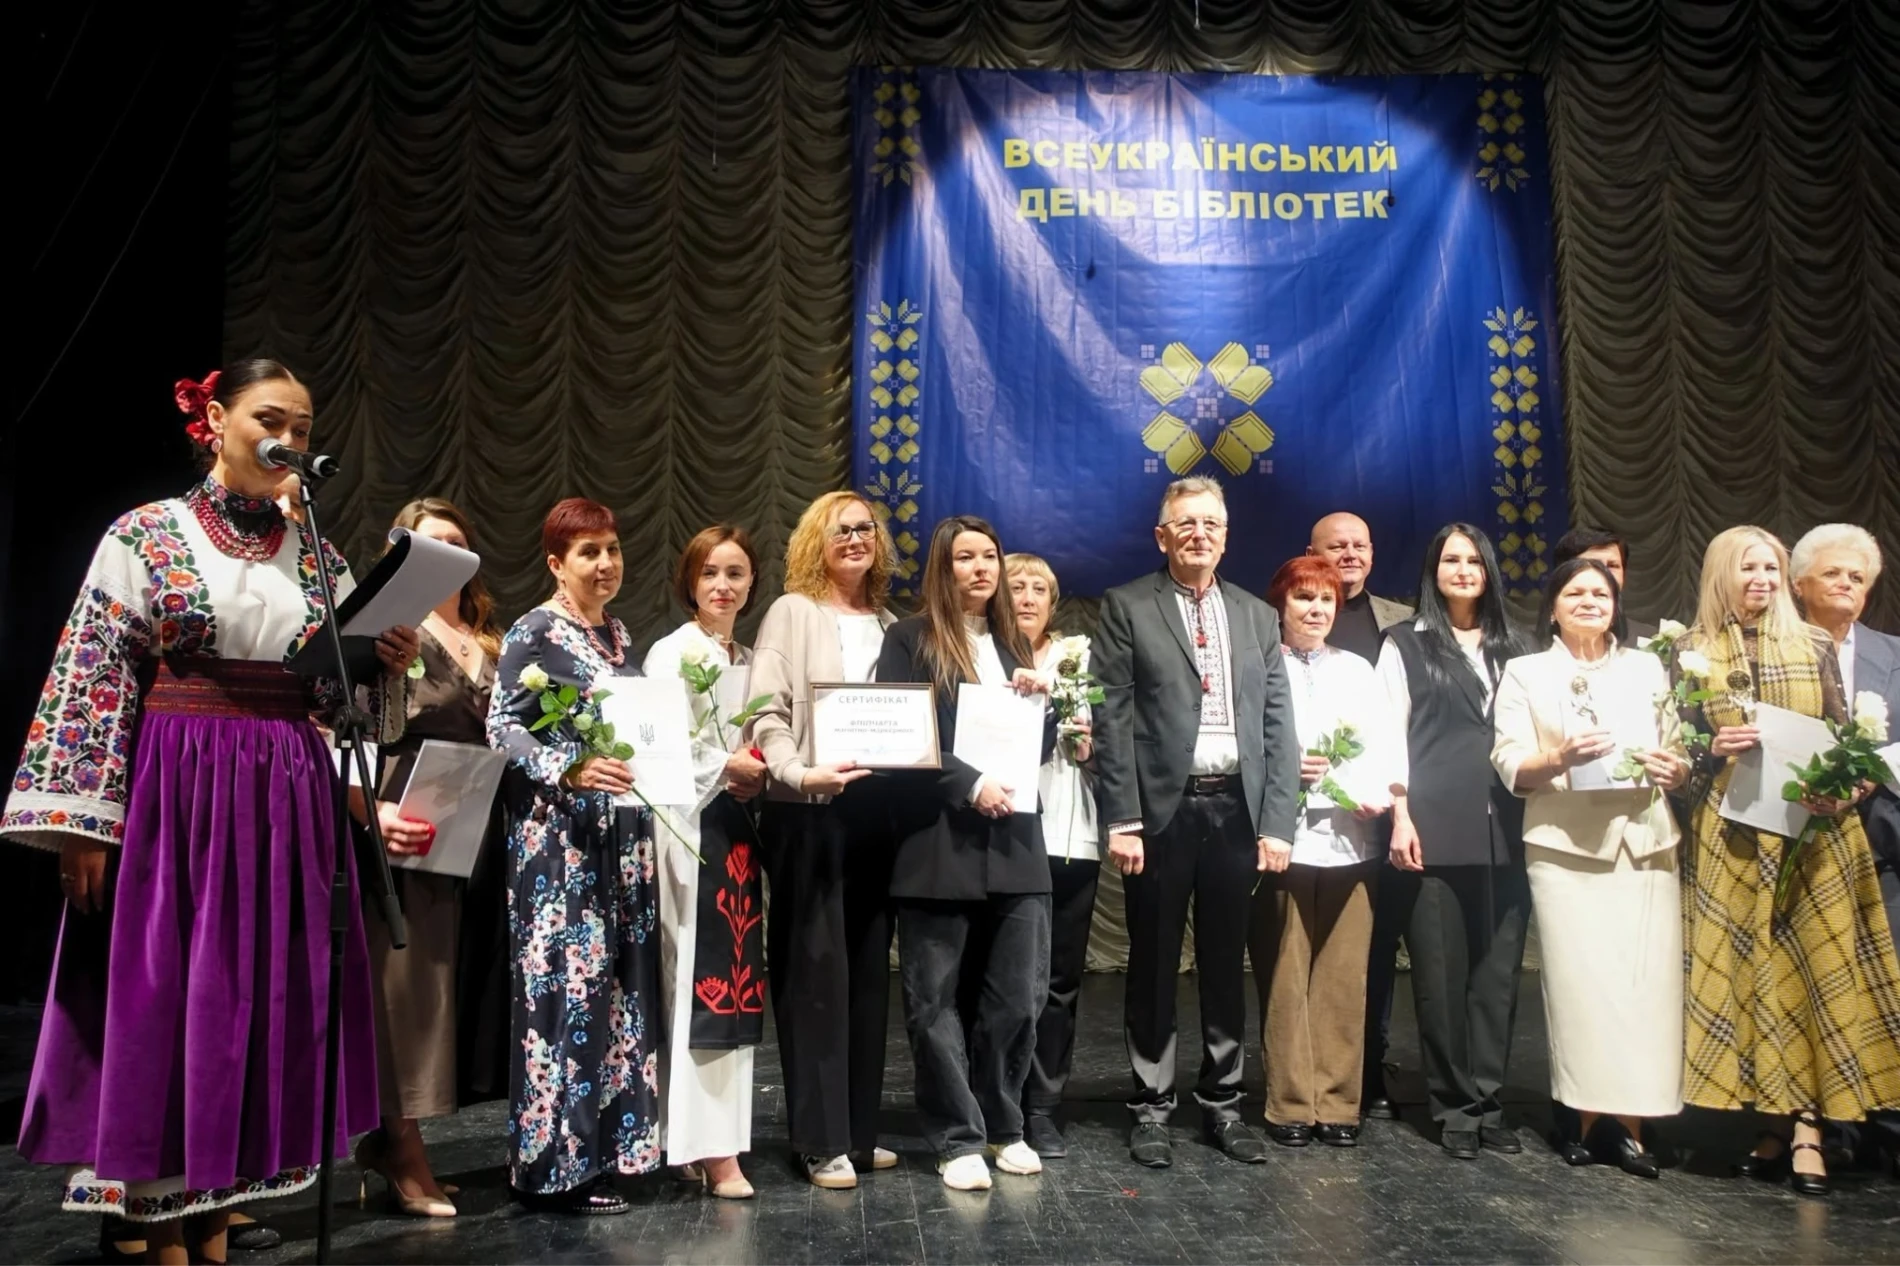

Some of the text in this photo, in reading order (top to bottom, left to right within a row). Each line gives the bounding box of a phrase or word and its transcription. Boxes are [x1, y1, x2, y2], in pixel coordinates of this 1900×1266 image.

[1004, 137, 1398, 173] ВСЕУКРАЇНСЬКИЙ
[1016, 188, 1390, 223] ДЕНЬ БІБЛІОТЕК
[838, 695, 909, 705] СЕРТИФІКАТ
